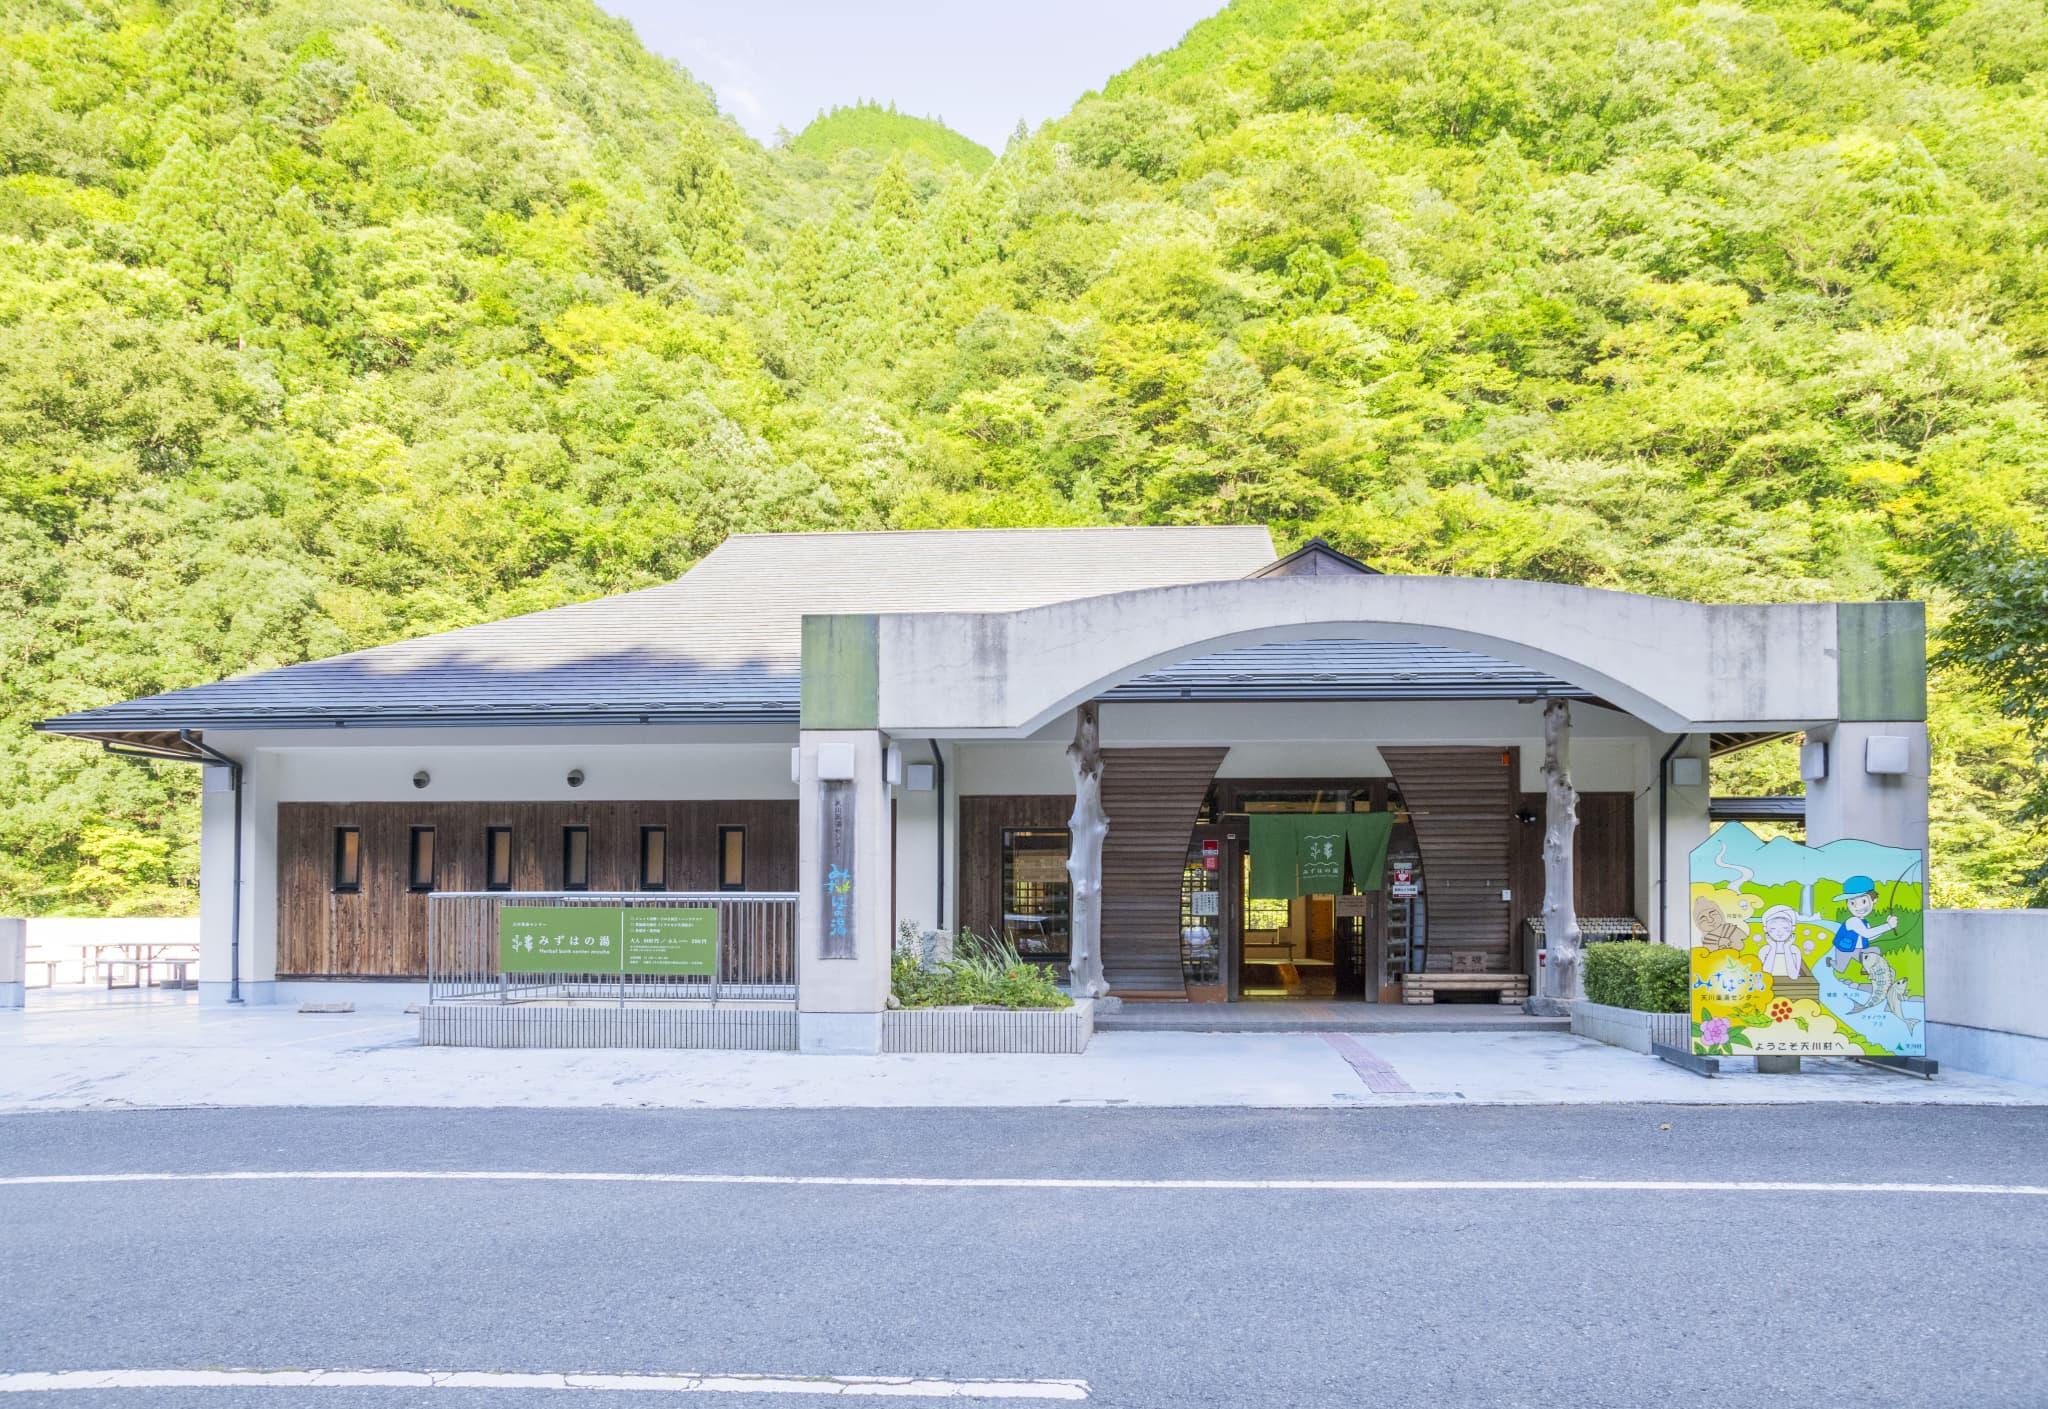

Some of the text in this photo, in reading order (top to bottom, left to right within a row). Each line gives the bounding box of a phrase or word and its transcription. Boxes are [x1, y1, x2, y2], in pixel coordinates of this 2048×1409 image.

[539, 935, 611, 946] みずはの湯
[1755, 1040, 1845, 1051] ようこそ天川村へ
